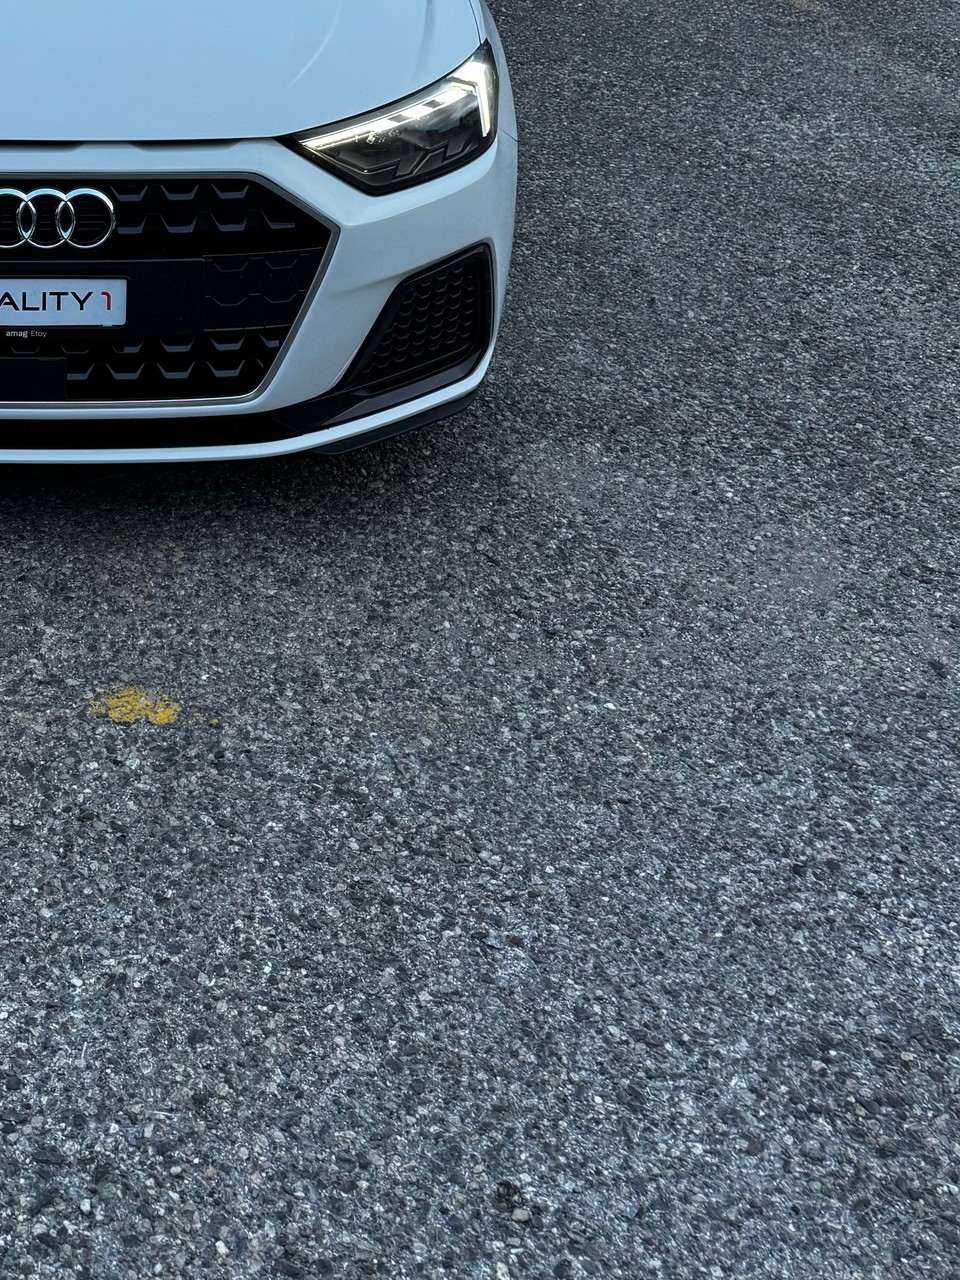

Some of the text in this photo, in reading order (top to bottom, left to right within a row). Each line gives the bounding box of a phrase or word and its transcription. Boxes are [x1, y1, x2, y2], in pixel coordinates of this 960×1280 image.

[101, 291, 112, 311] 1
[5, 330, 48, 338] amag Etoy
